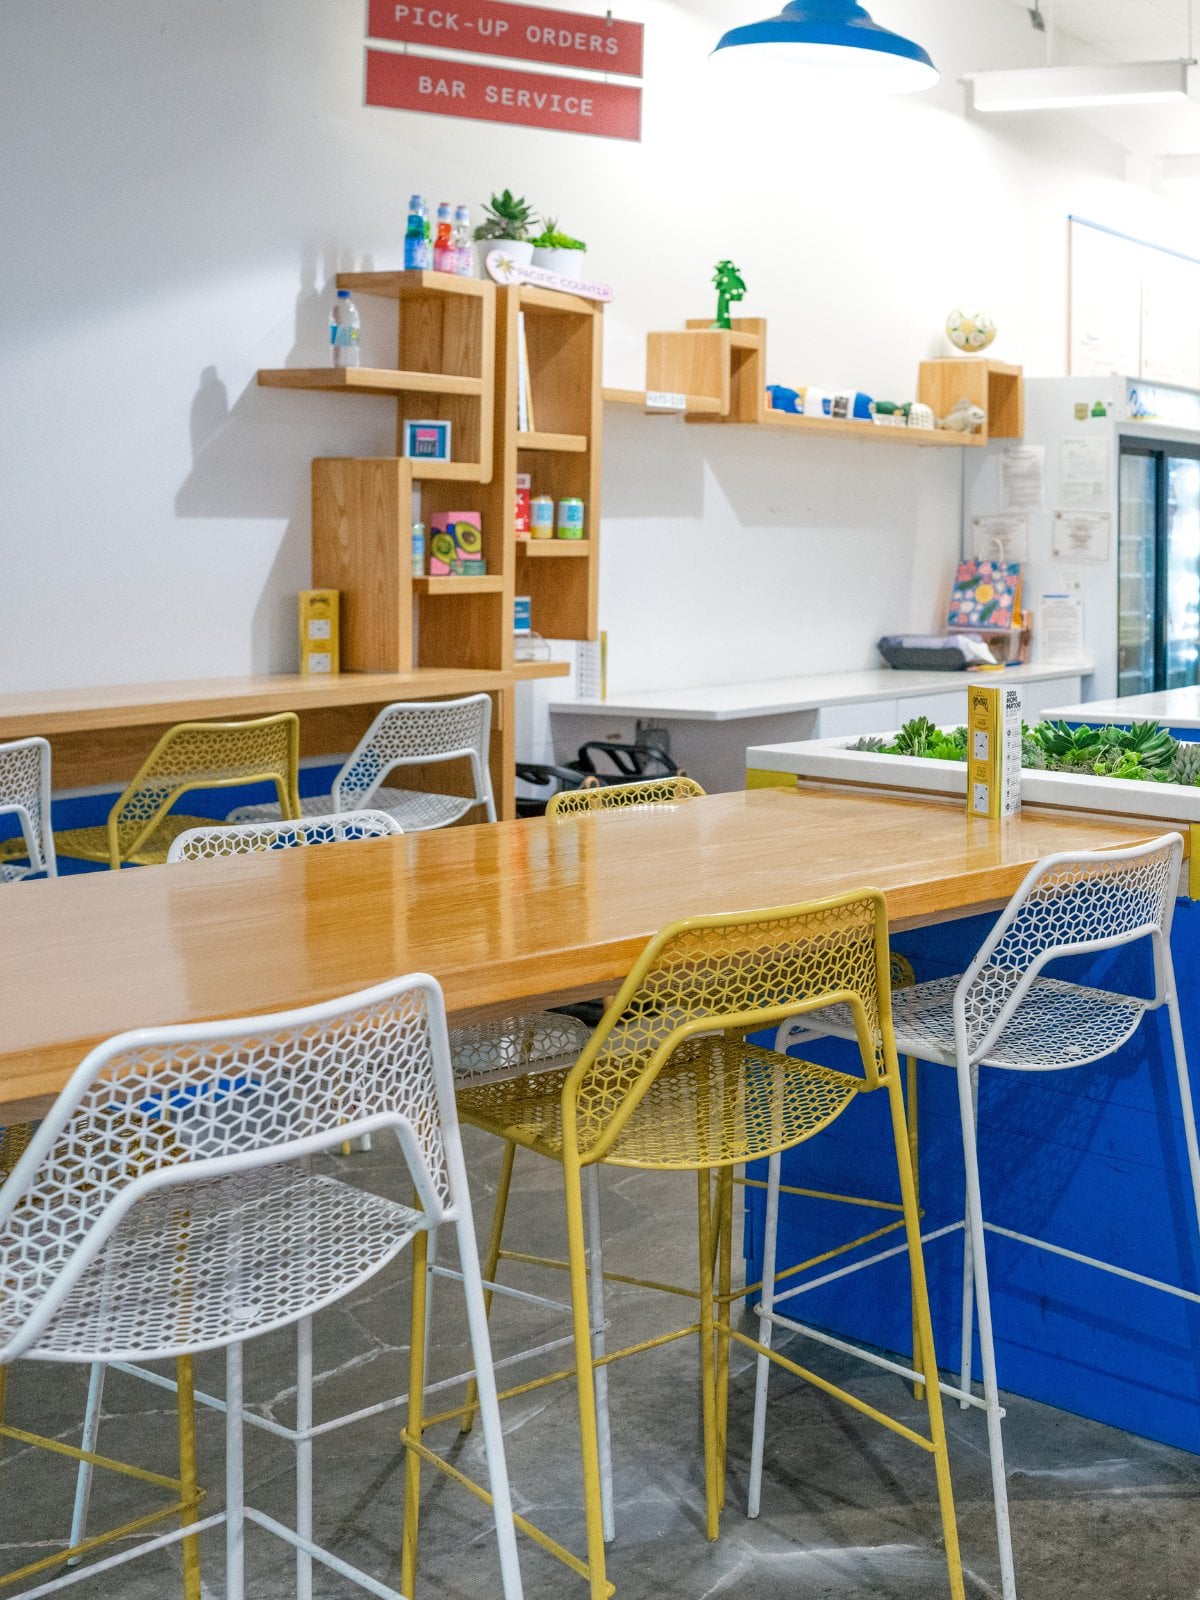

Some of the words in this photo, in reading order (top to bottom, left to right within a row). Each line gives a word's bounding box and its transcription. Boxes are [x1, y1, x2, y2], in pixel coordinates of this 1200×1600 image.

[394, 4, 509, 37] PICK-UP
[526, 25, 619, 55] ORDERS
[418, 76, 466, 98] BAR
[485, 85, 593, 116] SERVICE
[560, 278, 609, 297] COUNTER
